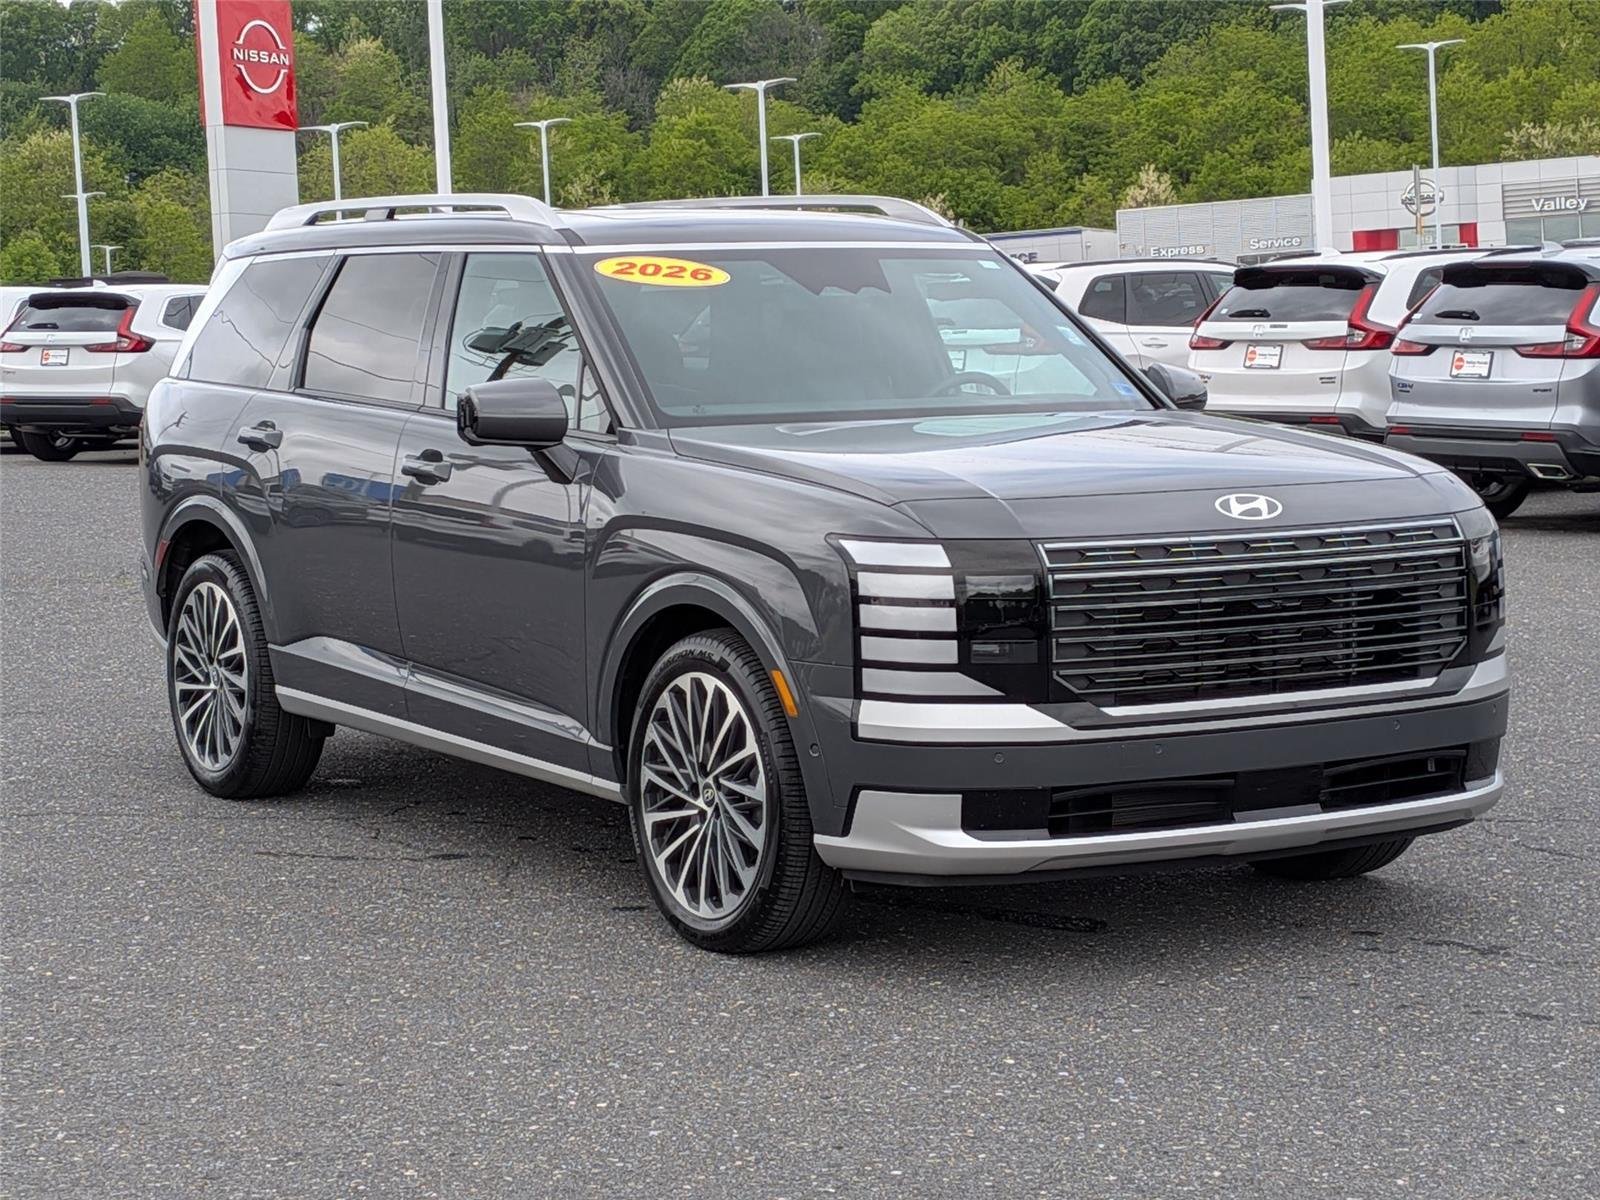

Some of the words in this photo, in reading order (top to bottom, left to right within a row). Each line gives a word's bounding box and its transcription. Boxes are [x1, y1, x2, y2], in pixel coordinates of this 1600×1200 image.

[233, 47, 289, 66] NISSAN
[1531, 196, 1588, 212] Valley
[1249, 236, 1302, 250] Service
[1150, 245, 1206, 258] Express
[611, 261, 714, 281] 2026
